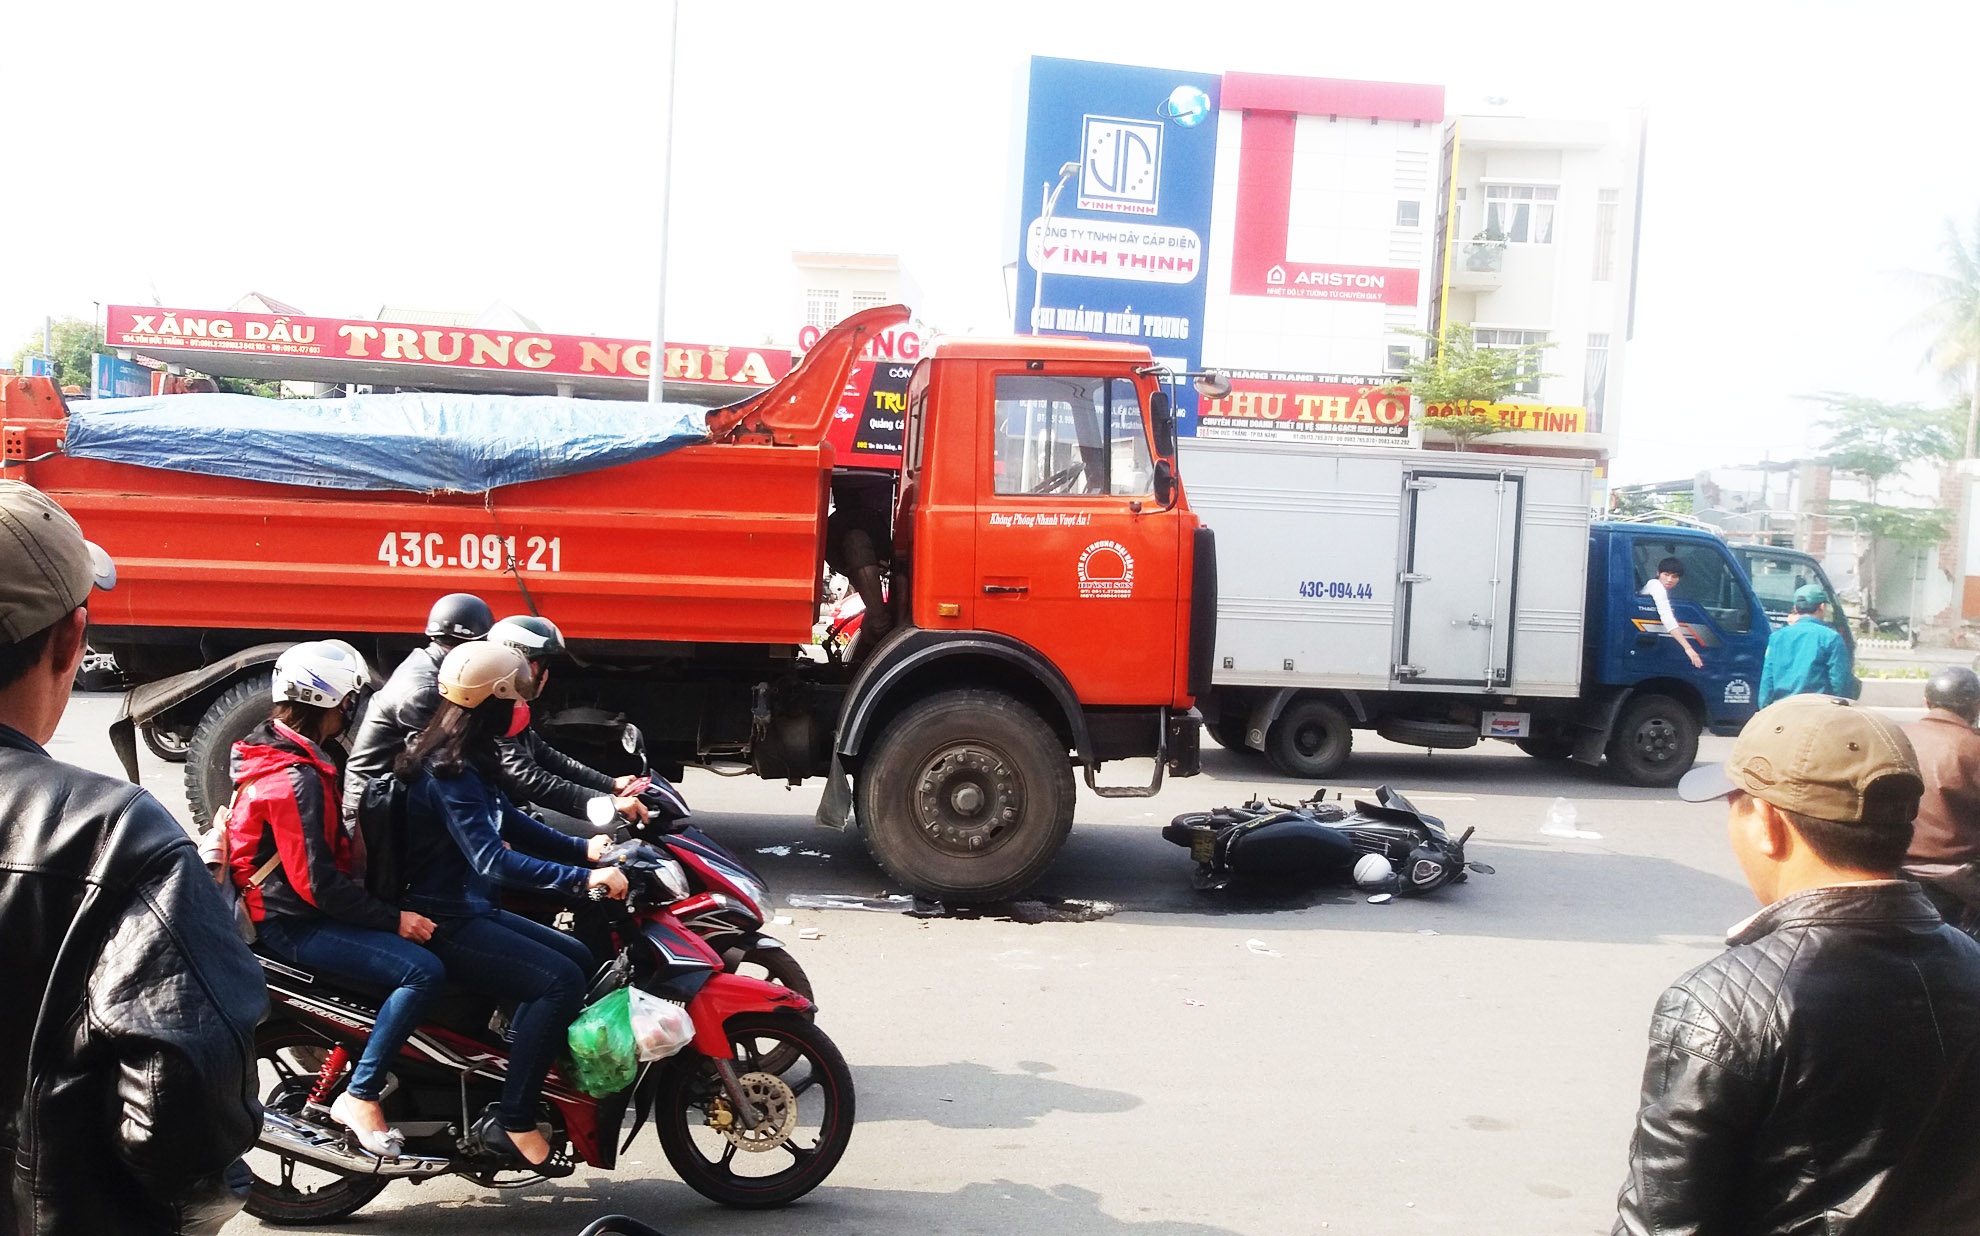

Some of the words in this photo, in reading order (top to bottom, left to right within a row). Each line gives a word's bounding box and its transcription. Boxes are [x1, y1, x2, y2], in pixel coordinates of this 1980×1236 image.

[1087, 231, 1117, 243] TNHH
[1119, 231, 1140, 245] DÂY
[1143, 232, 1166, 246] CÁP
[1168, 235, 1196, 250] ĐIỆN
[1117, 253, 1194, 273] THỊNH
[1294, 271, 1385, 288] ARISTON
[131, 312, 233, 339] XĂNG
[245, 316, 315, 344] DẦU
[1056, 304, 1104, 334] NHÁNH
[1105, 305, 1141, 336] MIỀN
[1143, 315, 1190, 340] TRUNG
[338, 325, 556, 368] TRUNG
[578, 341, 776, 384] NGHĨA
[1231, 368, 1268, 380] HÀNG
[1270, 373, 1314, 382] TRANG
[1317, 374, 1339, 383] TRÍ
[1342, 376, 1364, 385] NỘI
[1203, 391, 1287, 420] THU
[1294, 387, 1406, 425] THẢO
[1202, 417, 1231, 427] CHUYÊN
[1231, 418, 1249, 428] KINH
[1249, 419, 1273, 429] DOANH
[1274, 419, 1296, 430] THIẾT
[1373, 426, 1388, 434] CAO
[1388, 425, 1404, 435] CẤP
[1498, 404, 1527, 429] TỪ
[1533, 406, 1578, 433] TÍNH
[1035, 512, 1058, 526] Nhanh
[1299, 581, 1373, 600] 43C-094.44
[283, 998, 365, 1029] SIRIUS
